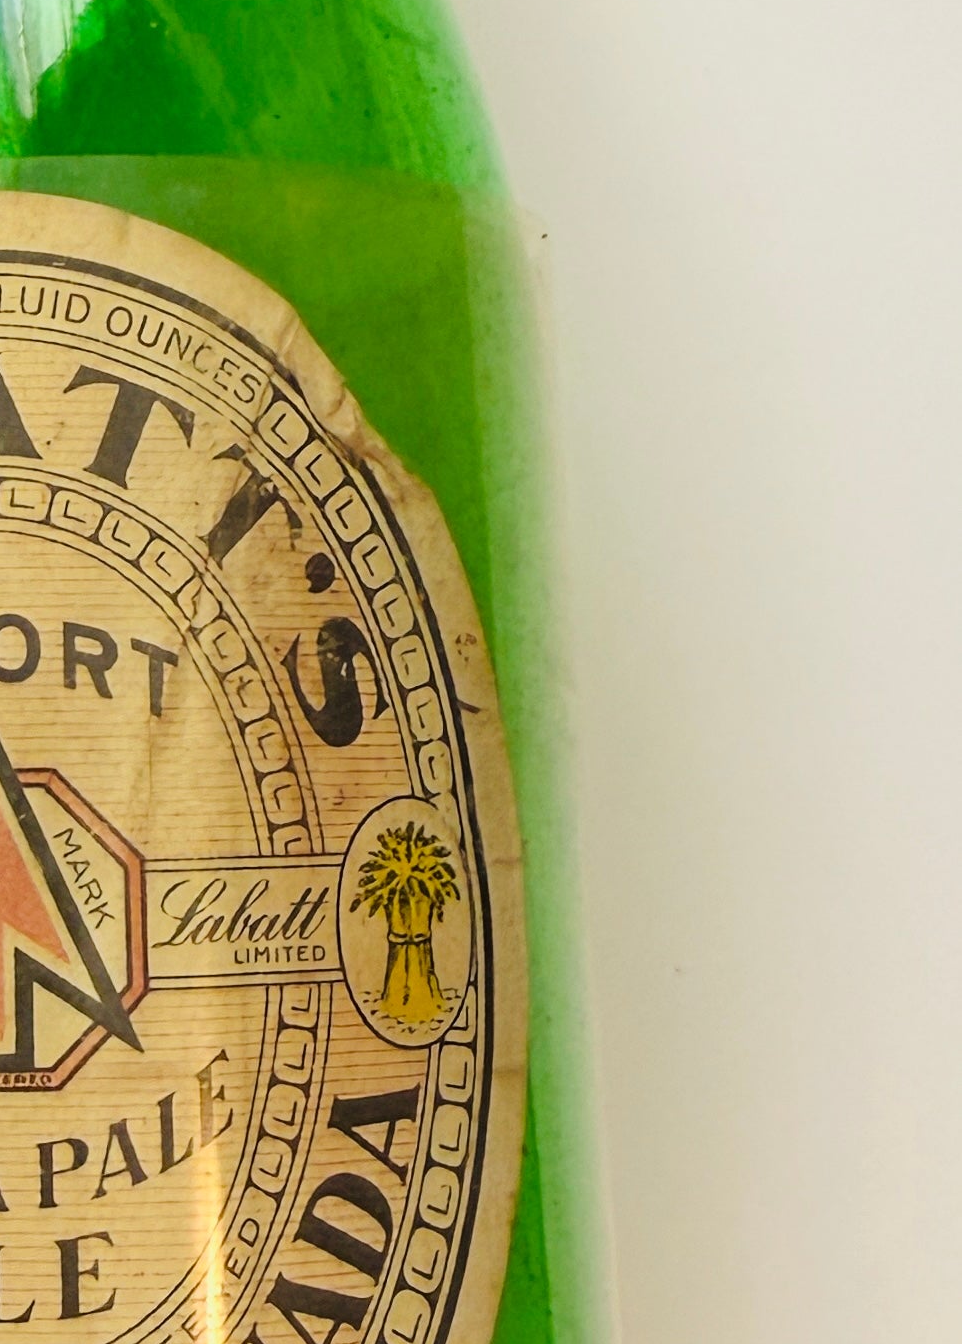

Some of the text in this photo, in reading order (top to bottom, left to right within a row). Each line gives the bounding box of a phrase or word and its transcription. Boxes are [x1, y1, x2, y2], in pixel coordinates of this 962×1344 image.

[105, 306, 263, 406] OUNCES
[53, 827, 116, 930] MARK
[152, 878, 329, 949] Labatt
[233, 944, 326, 965] LIMITED
[37, 1048, 235, 1210] PALE
